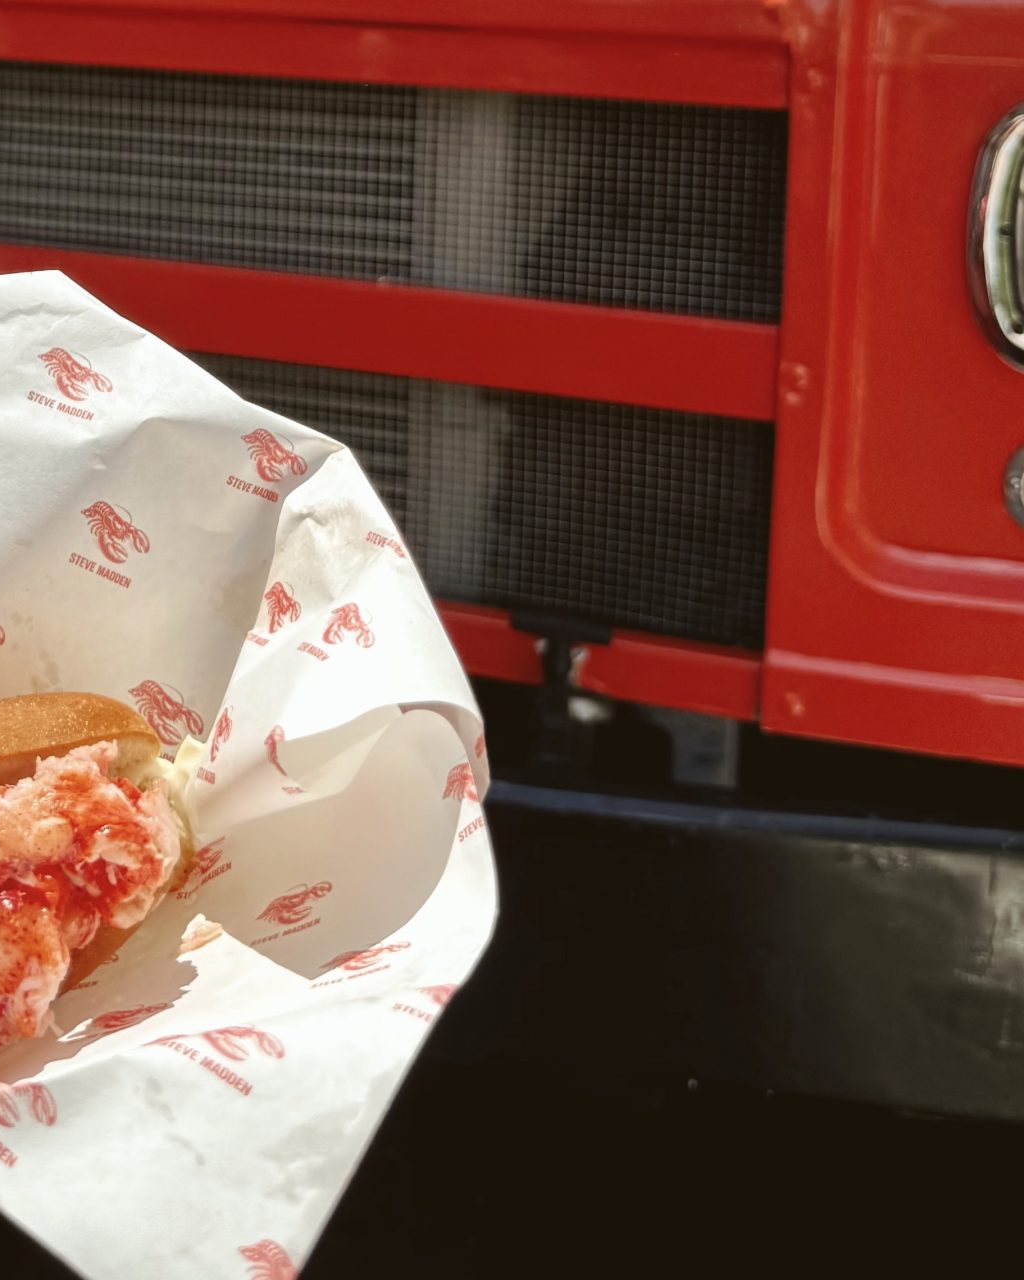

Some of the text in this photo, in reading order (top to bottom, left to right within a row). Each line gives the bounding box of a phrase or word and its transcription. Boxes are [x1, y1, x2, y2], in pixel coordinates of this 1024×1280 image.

[27, 390, 94, 421] STEVE MADDEN
[226, 475, 253, 494] STEVE
[68, 552, 132, 589] STEVE MADDEN
[458, 816, 485, 843] STEVE
[199, 1055, 254, 1097] MADDEN
